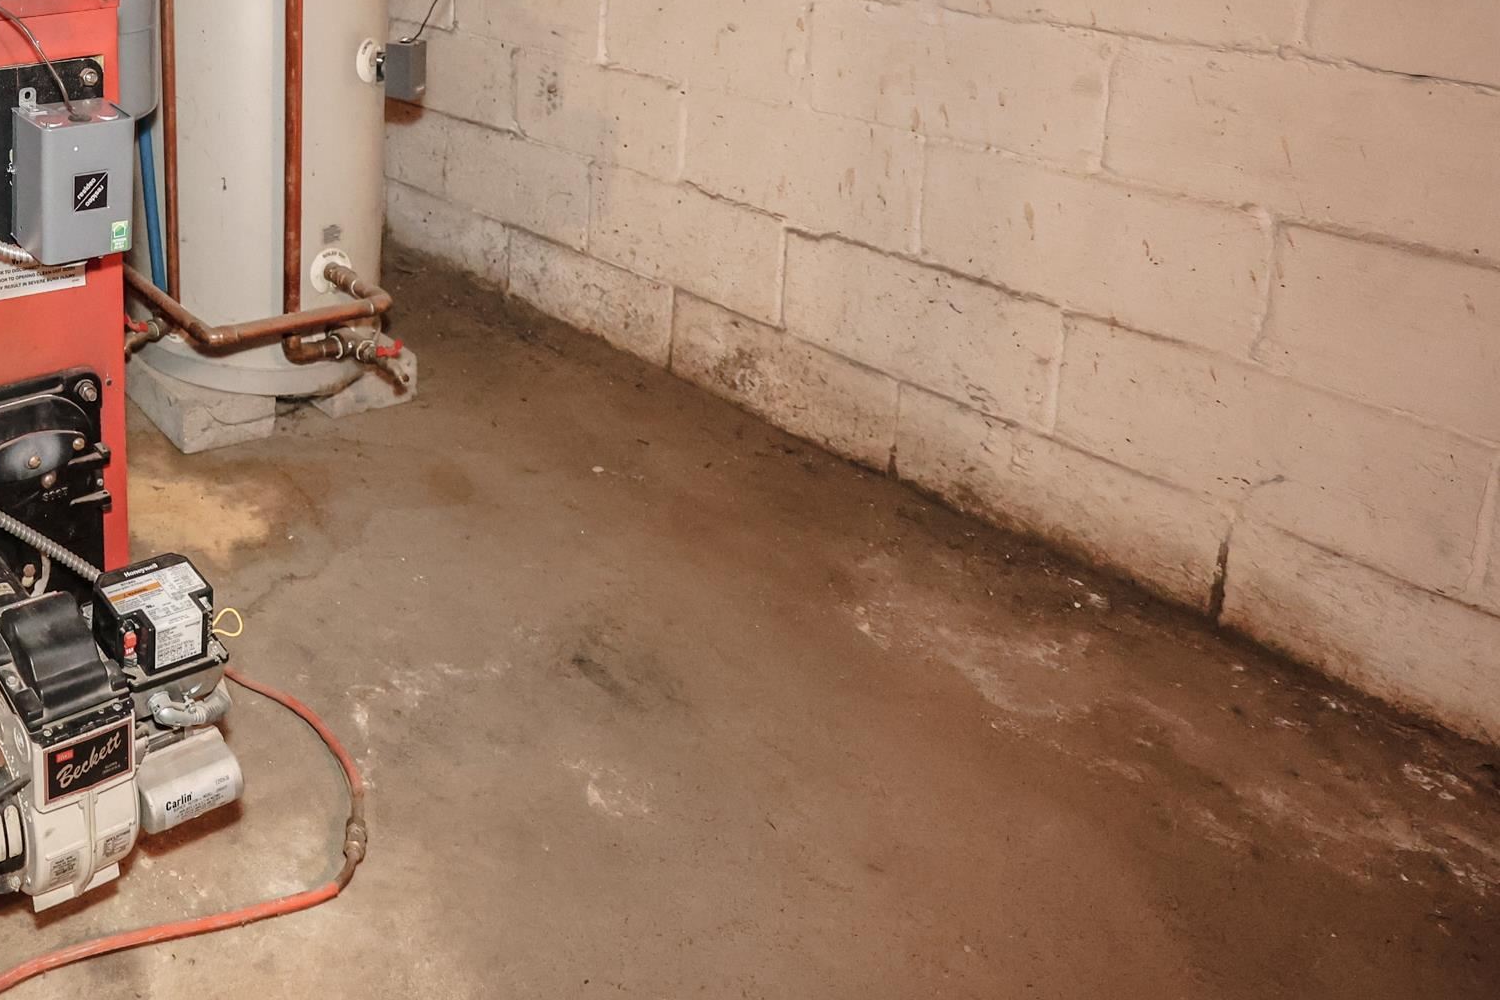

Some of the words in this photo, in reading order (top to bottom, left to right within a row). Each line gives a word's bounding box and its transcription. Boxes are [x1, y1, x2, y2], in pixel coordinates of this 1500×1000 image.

[76, 177, 97, 200] resideo
[84, 184, 104, 207] resideo
[123, 562, 159, 578] Honeywell
[55, 731, 122, 789] Beckett
[165, 791, 192, 811] Carlin
